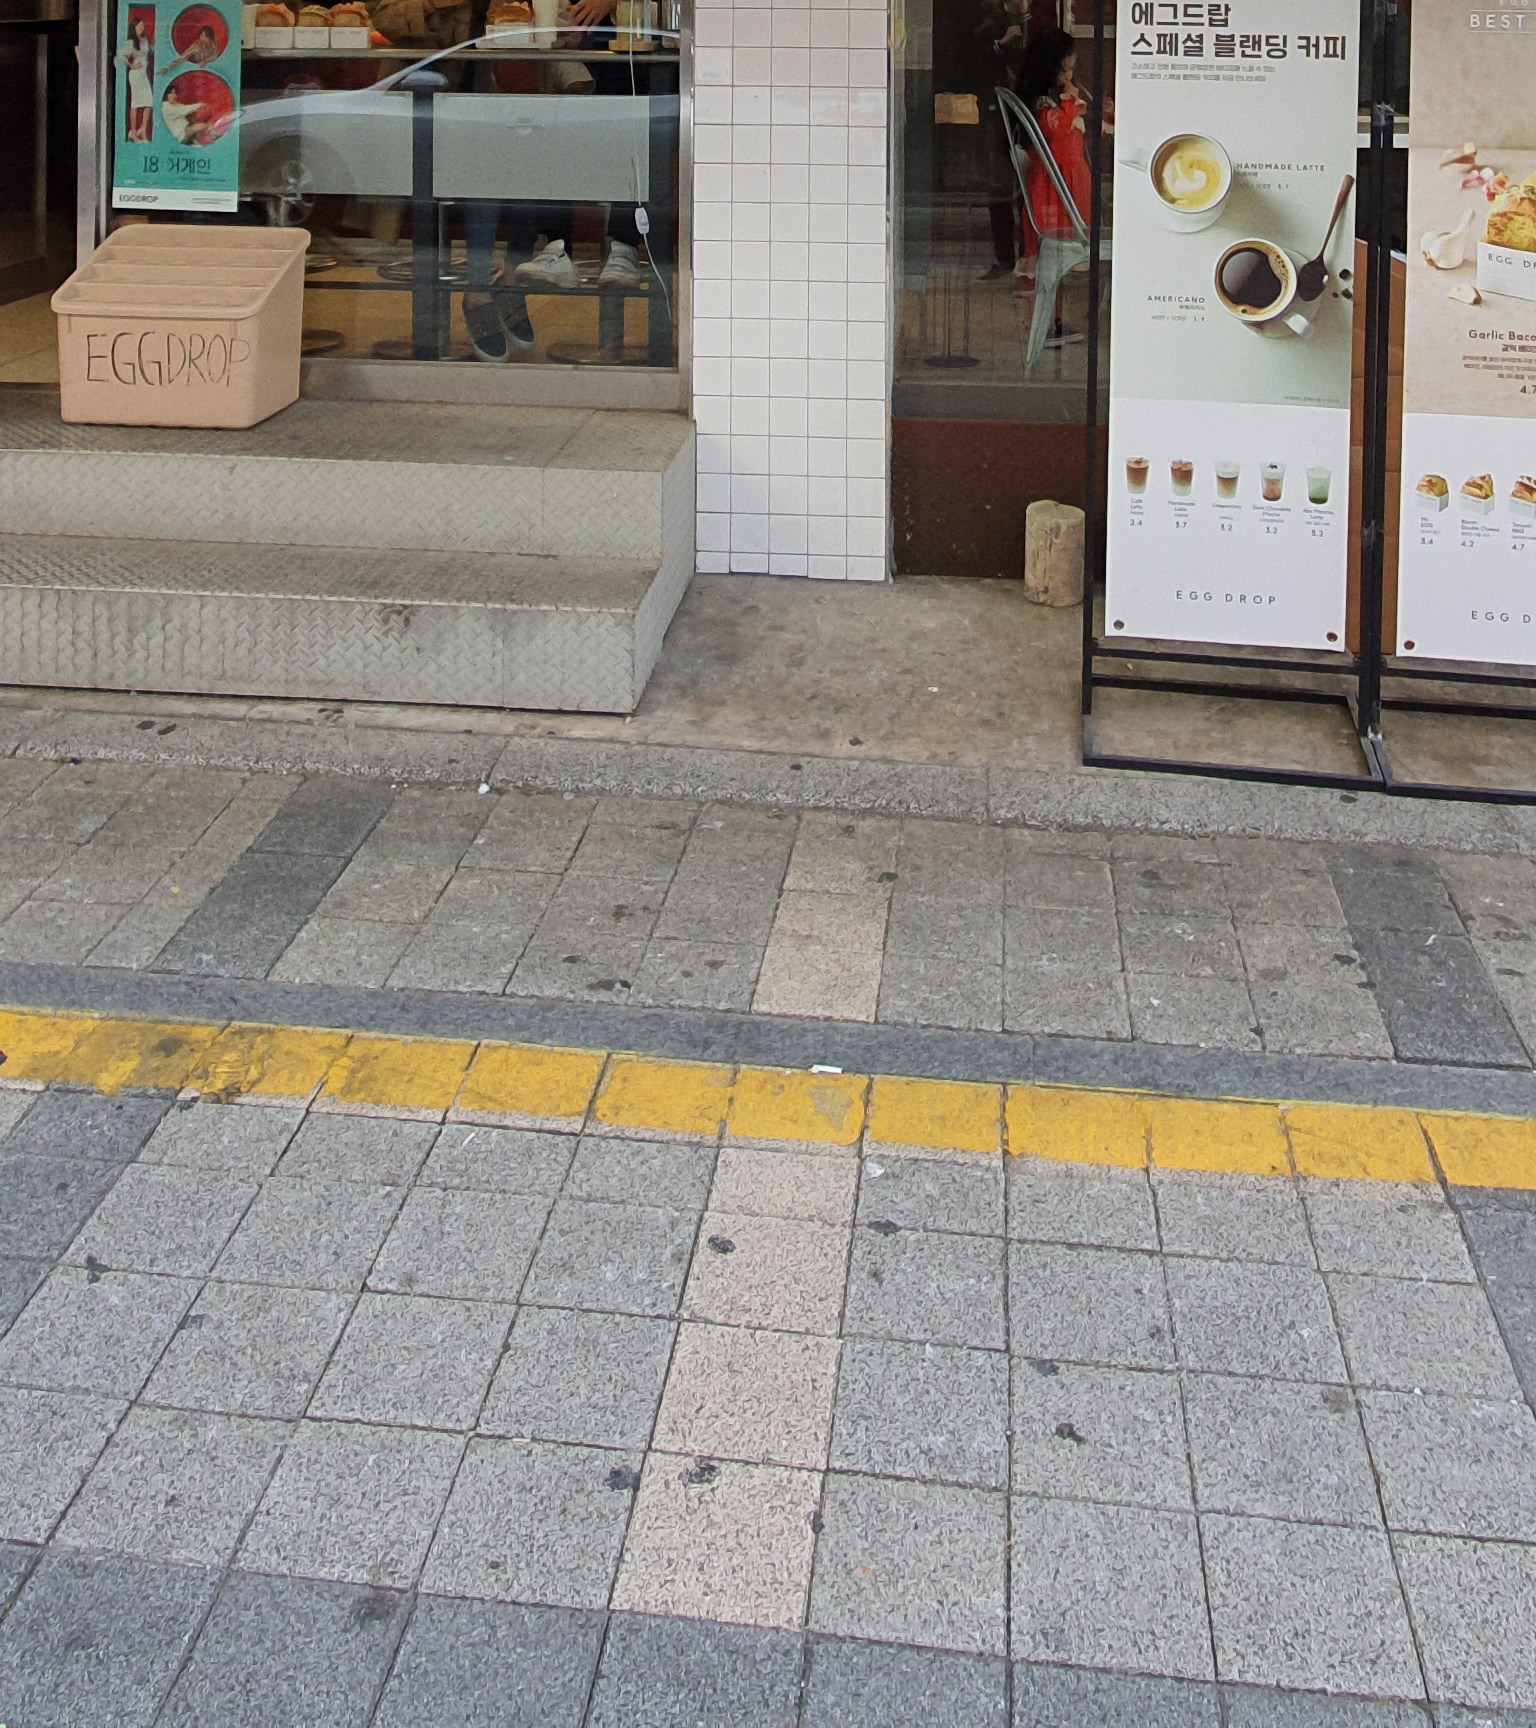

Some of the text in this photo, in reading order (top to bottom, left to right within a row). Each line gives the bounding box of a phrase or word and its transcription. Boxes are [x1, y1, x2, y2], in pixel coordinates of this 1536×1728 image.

[1131, 2, 1231, 27] 에그드랍
[1469, 14, 1525, 28] BEST
[1130, 33, 1346, 60] 스페셜 블랜딩 커피
[1236, 162, 1292, 170] HANDMADE
[1488, 253, 1513, 265] EGG
[1147, 295, 1205, 304] AMERICANO
[1468, 329, 1504, 341] Garlic
[1176, 590, 1276, 605] EGG DROP
[1471, 610, 1510, 622] EGG
